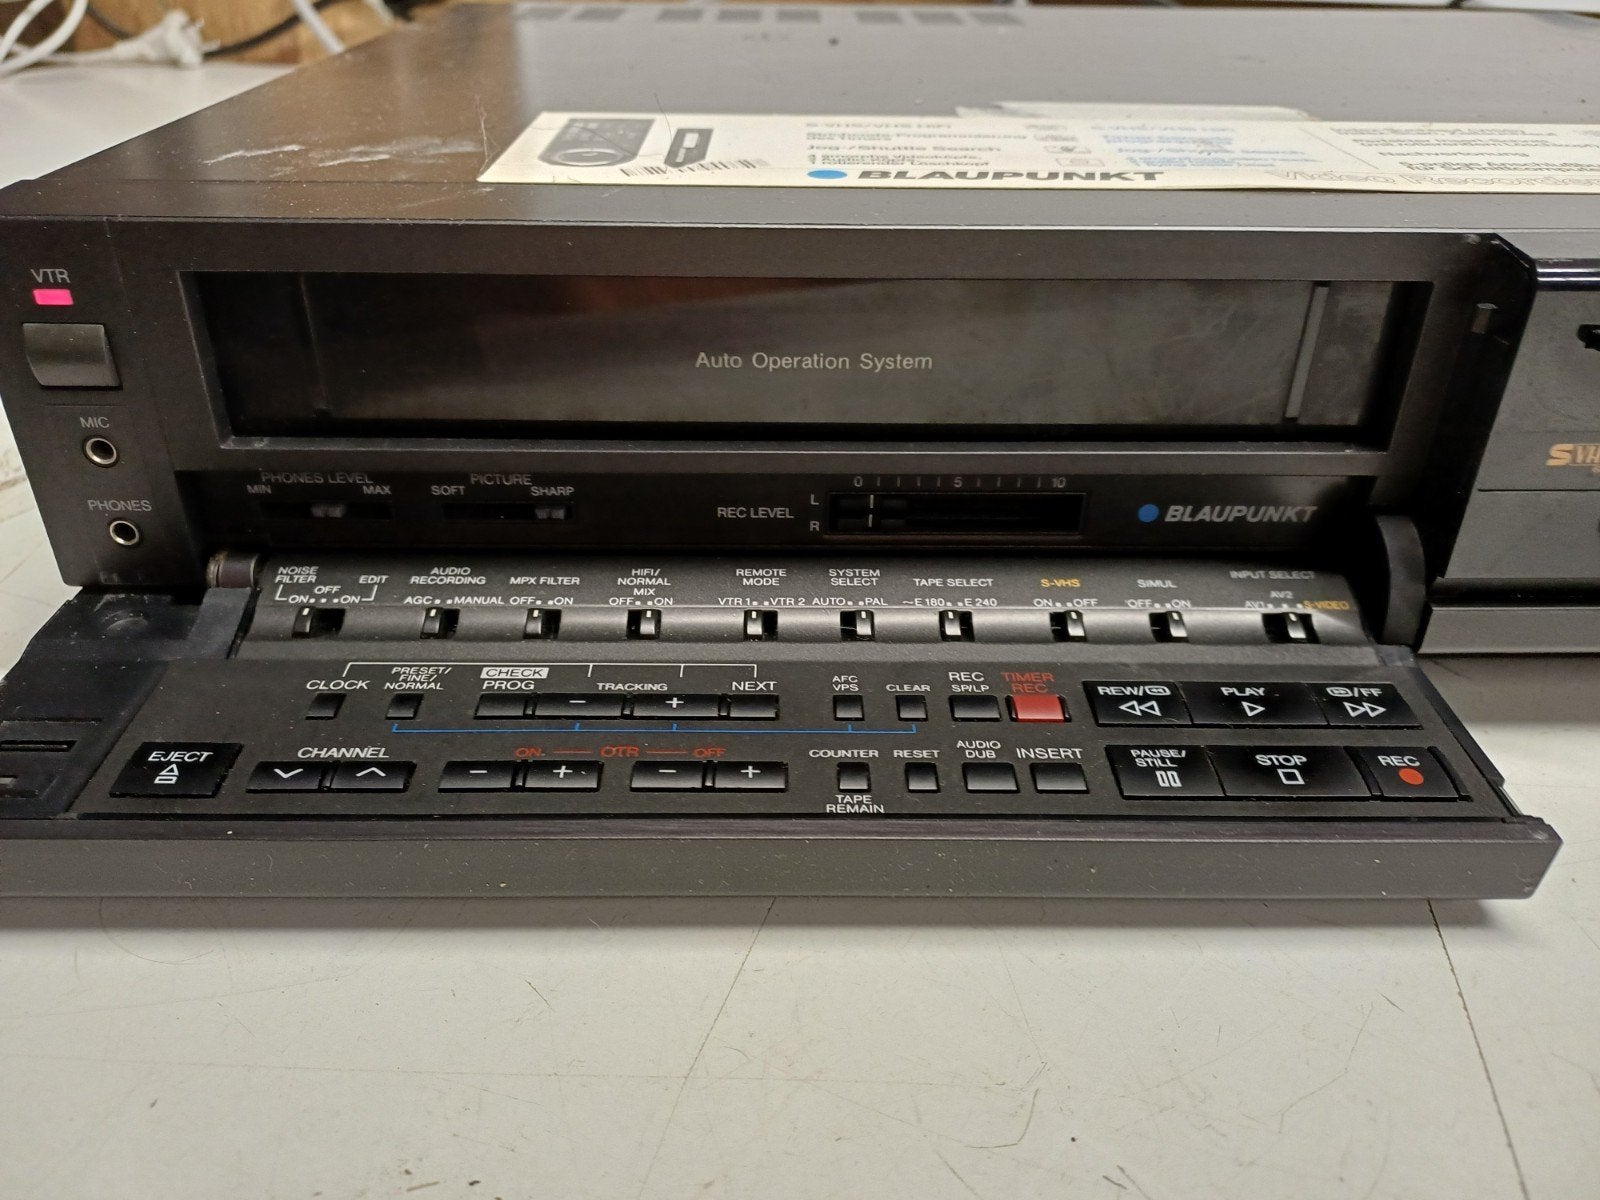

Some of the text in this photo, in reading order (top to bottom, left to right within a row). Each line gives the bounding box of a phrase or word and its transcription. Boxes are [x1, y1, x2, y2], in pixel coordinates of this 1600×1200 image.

[858, 170, 1164, 182] BLAUPUNKT
[31, 269, 71, 283] VTR
[695, 352, 933, 373] Auto Operation System
[80, 416, 109, 429] MIC
[260, 472, 374, 485] PHONES LEVEL
[471, 473, 533, 486] PICTURE
[953, 476, 963, 487] 5
[1052, 477, 1066, 488] 10
[247, 484, 392, 496] MIN MAX
[431, 485, 575, 497] SOFT SHARP
[87, 500, 152, 513] PHONES
[717, 507, 794, 520] REC LEVEL
[1164, 505, 1318, 523] BLAUPUNKT
[809, 521, 820, 532] R
[278, 566, 318, 575] NOISE
[430, 567, 471, 575] AUDIO
[631, 568, 660, 577] HIFI/
[735, 568, 787, 577] REMOTE
[828, 568, 881, 577] SYSTEM
[1230, 570, 1315, 581] INPUT SELECT
[275, 575, 317, 584] FILTER
[358, 575, 389, 584] EDIT
[410, 576, 486, 585] RECORDING
[509, 576, 580, 586] MPX FILTER
[617, 577, 671, 586] NORMAL
[742, 577, 780, 587] MODE
[830, 577, 879, 587] SELECT
[913, 578, 994, 587] TAPE SELECT
[1040, 578, 1081, 588] S-VHS
[1137, 579, 1178, 589] SIMUL
[314, 585, 341, 594] OFF
[633, 587, 655, 596] MIX
[288, 595, 361, 604] ON ON
[403, 597, 504, 606] AGC MANUAL
[509, 597, 574, 606] OFF ON
[609, 597, 673, 606] OFF ON
[718, 597, 743, 606] VTR
[769, 597, 795, 606] VTR
[812, 597, 888, 606] AUTO PAL
[1033, 599, 1098, 608] ON OFF
[1127, 600, 1191, 609] OFF ON
[391, 667, 451, 675] PRESET/
[485, 668, 545, 678] CHECK
[832, 675, 858, 683] AFC
[949, 671, 984, 682] REC
[1003, 672, 1054, 682] TIMER
[306, 680, 369, 690] CLOCK
[384, 682, 443, 690] NORMAL
[482, 680, 535, 691] PROG
[597, 682, 667, 691] TRACKING
[731, 681, 777, 691] NEXT
[832, 683, 859, 692] VPS
[886, 684, 931, 692] CLEAR
[1011, 683, 1047, 693] REC
[1220, 686, 1265, 697] PLAY
[956, 740, 1001, 749] AUDIO
[148, 751, 213, 762] EJECT
[297, 746, 390, 759] CHANNEL
[514, 746, 727, 757] ON OTR OFF
[808, 749, 879, 758] COUNTER
[893, 749, 940, 758] RESET
[965, 749, 996, 759] DUB
[1016, 747, 1083, 760] INSERT
[1130, 748, 1187, 759] PAUSE/
[1135, 757, 1179, 768] STILL
[1255, 754, 1308, 767] STOP
[1377, 755, 1421, 767] REC
[836, 794, 872, 804] TAPE
[826, 804, 885, 814] REMAIN
